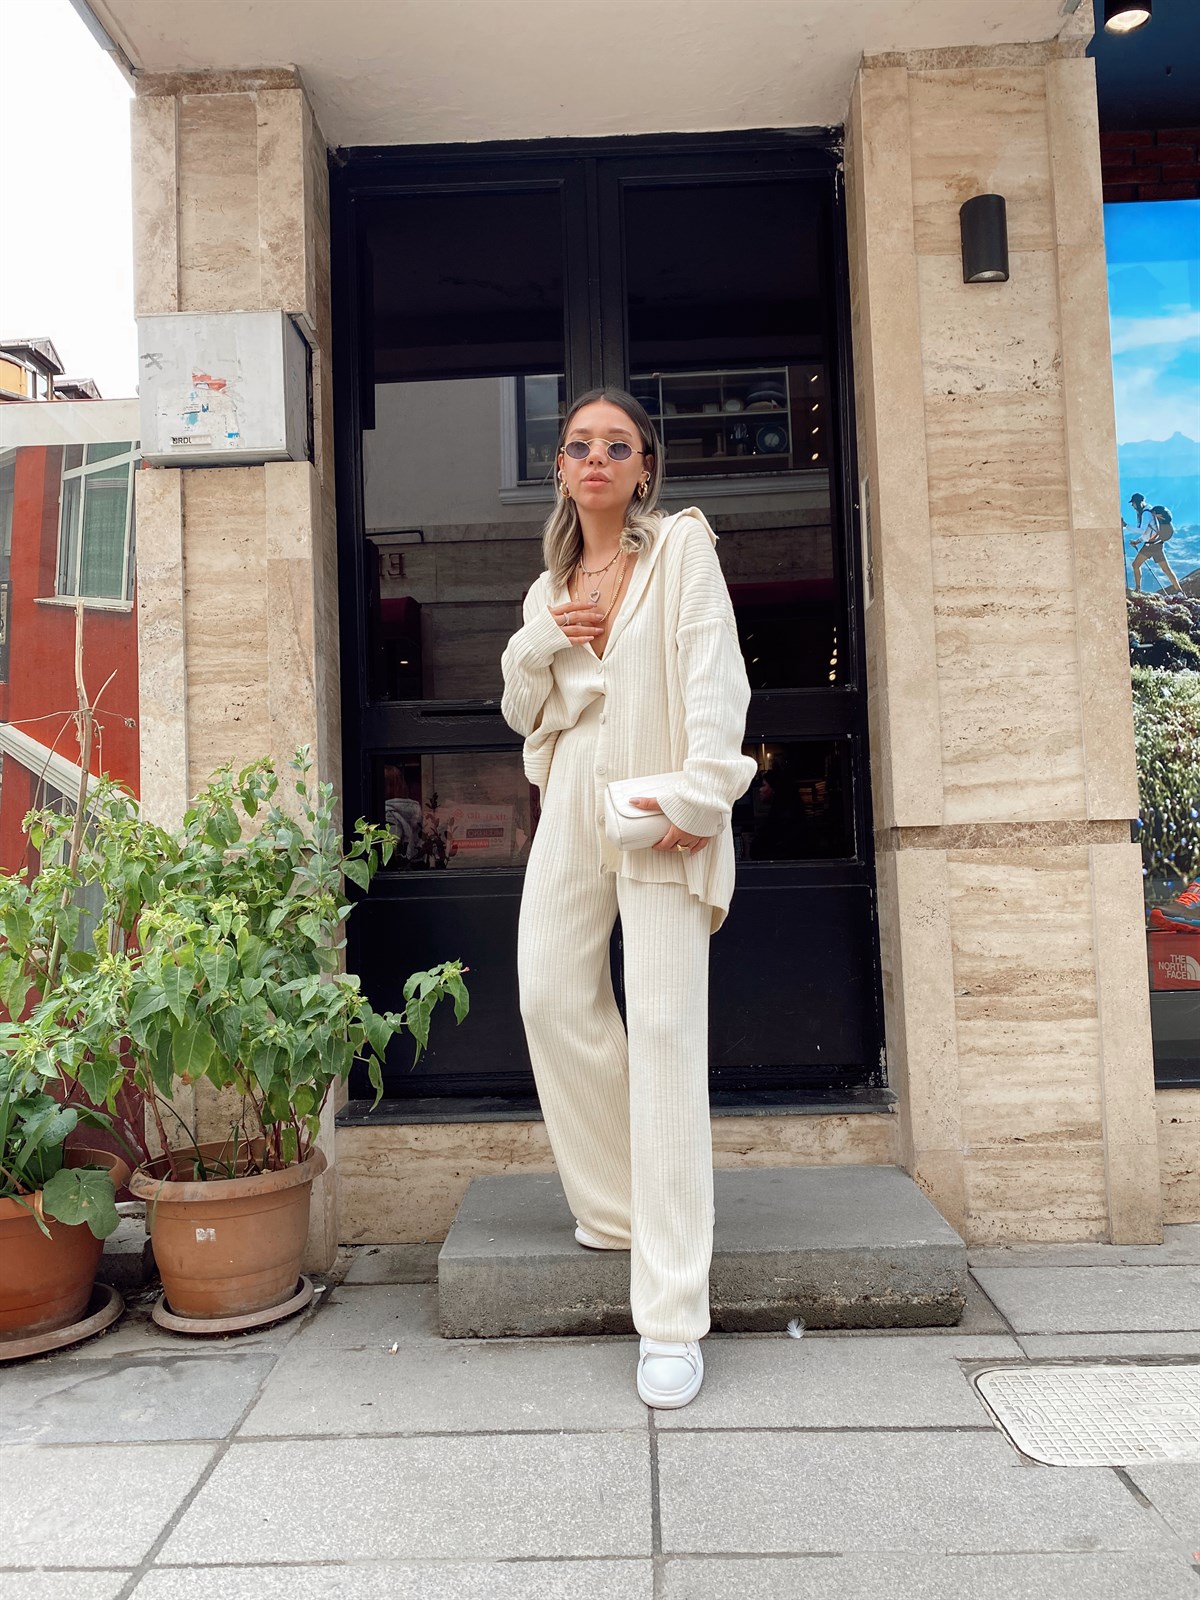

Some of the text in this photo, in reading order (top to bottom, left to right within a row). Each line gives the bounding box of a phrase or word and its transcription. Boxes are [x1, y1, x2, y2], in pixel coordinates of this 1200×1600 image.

[1169, 954, 1186, 964] THE
[1157, 961, 1187, 971] NORTH
[1167, 971, 1187, 980] FACE
